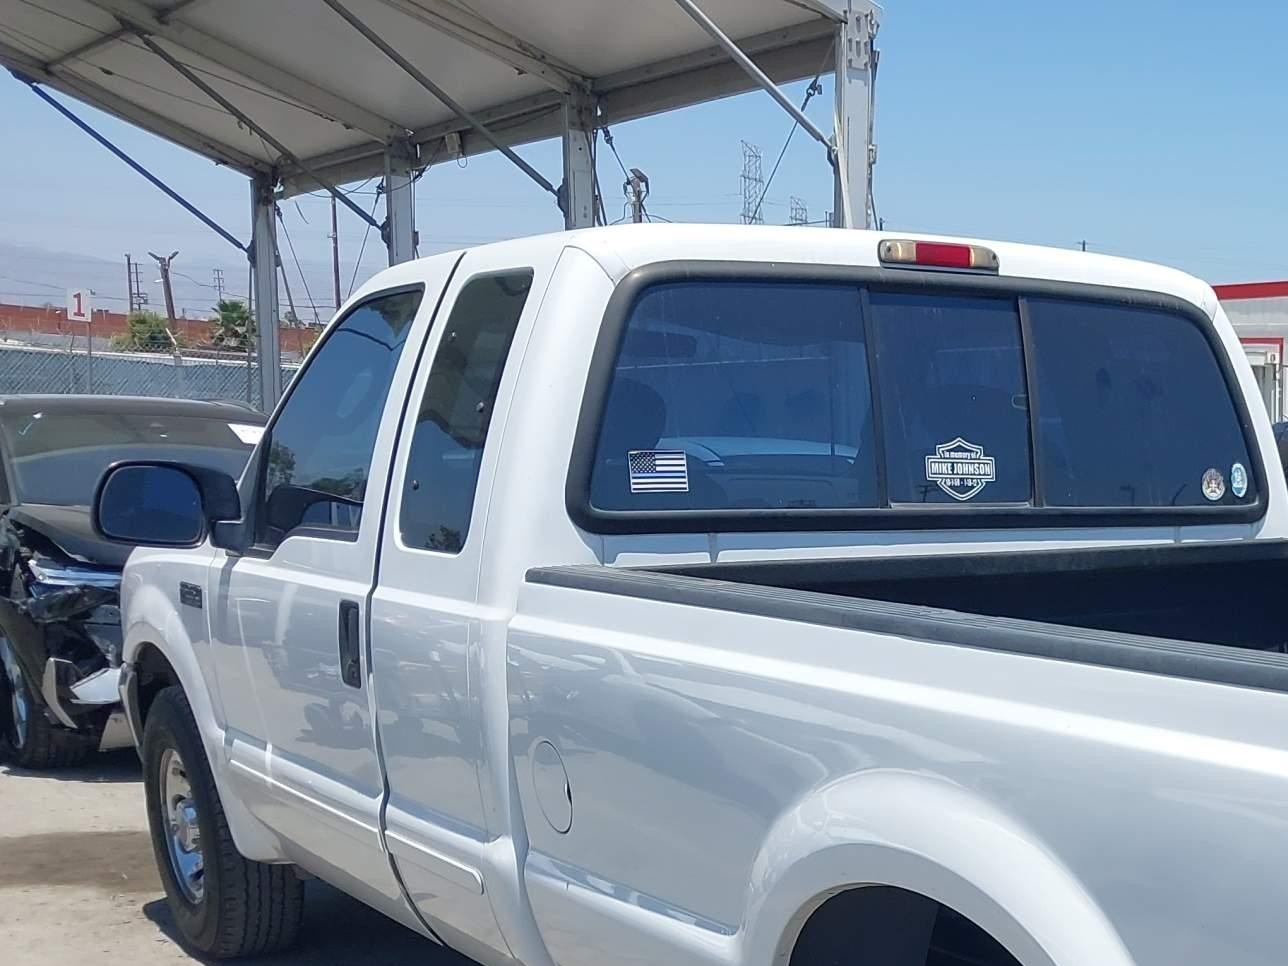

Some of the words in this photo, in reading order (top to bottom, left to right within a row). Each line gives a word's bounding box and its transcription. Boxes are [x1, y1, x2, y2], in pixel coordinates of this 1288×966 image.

[73, 292, 85, 317] 1
[950, 451, 971, 460] memory
[931, 462, 953, 474] MIKE
[953, 463, 991, 475] JOHNSON
